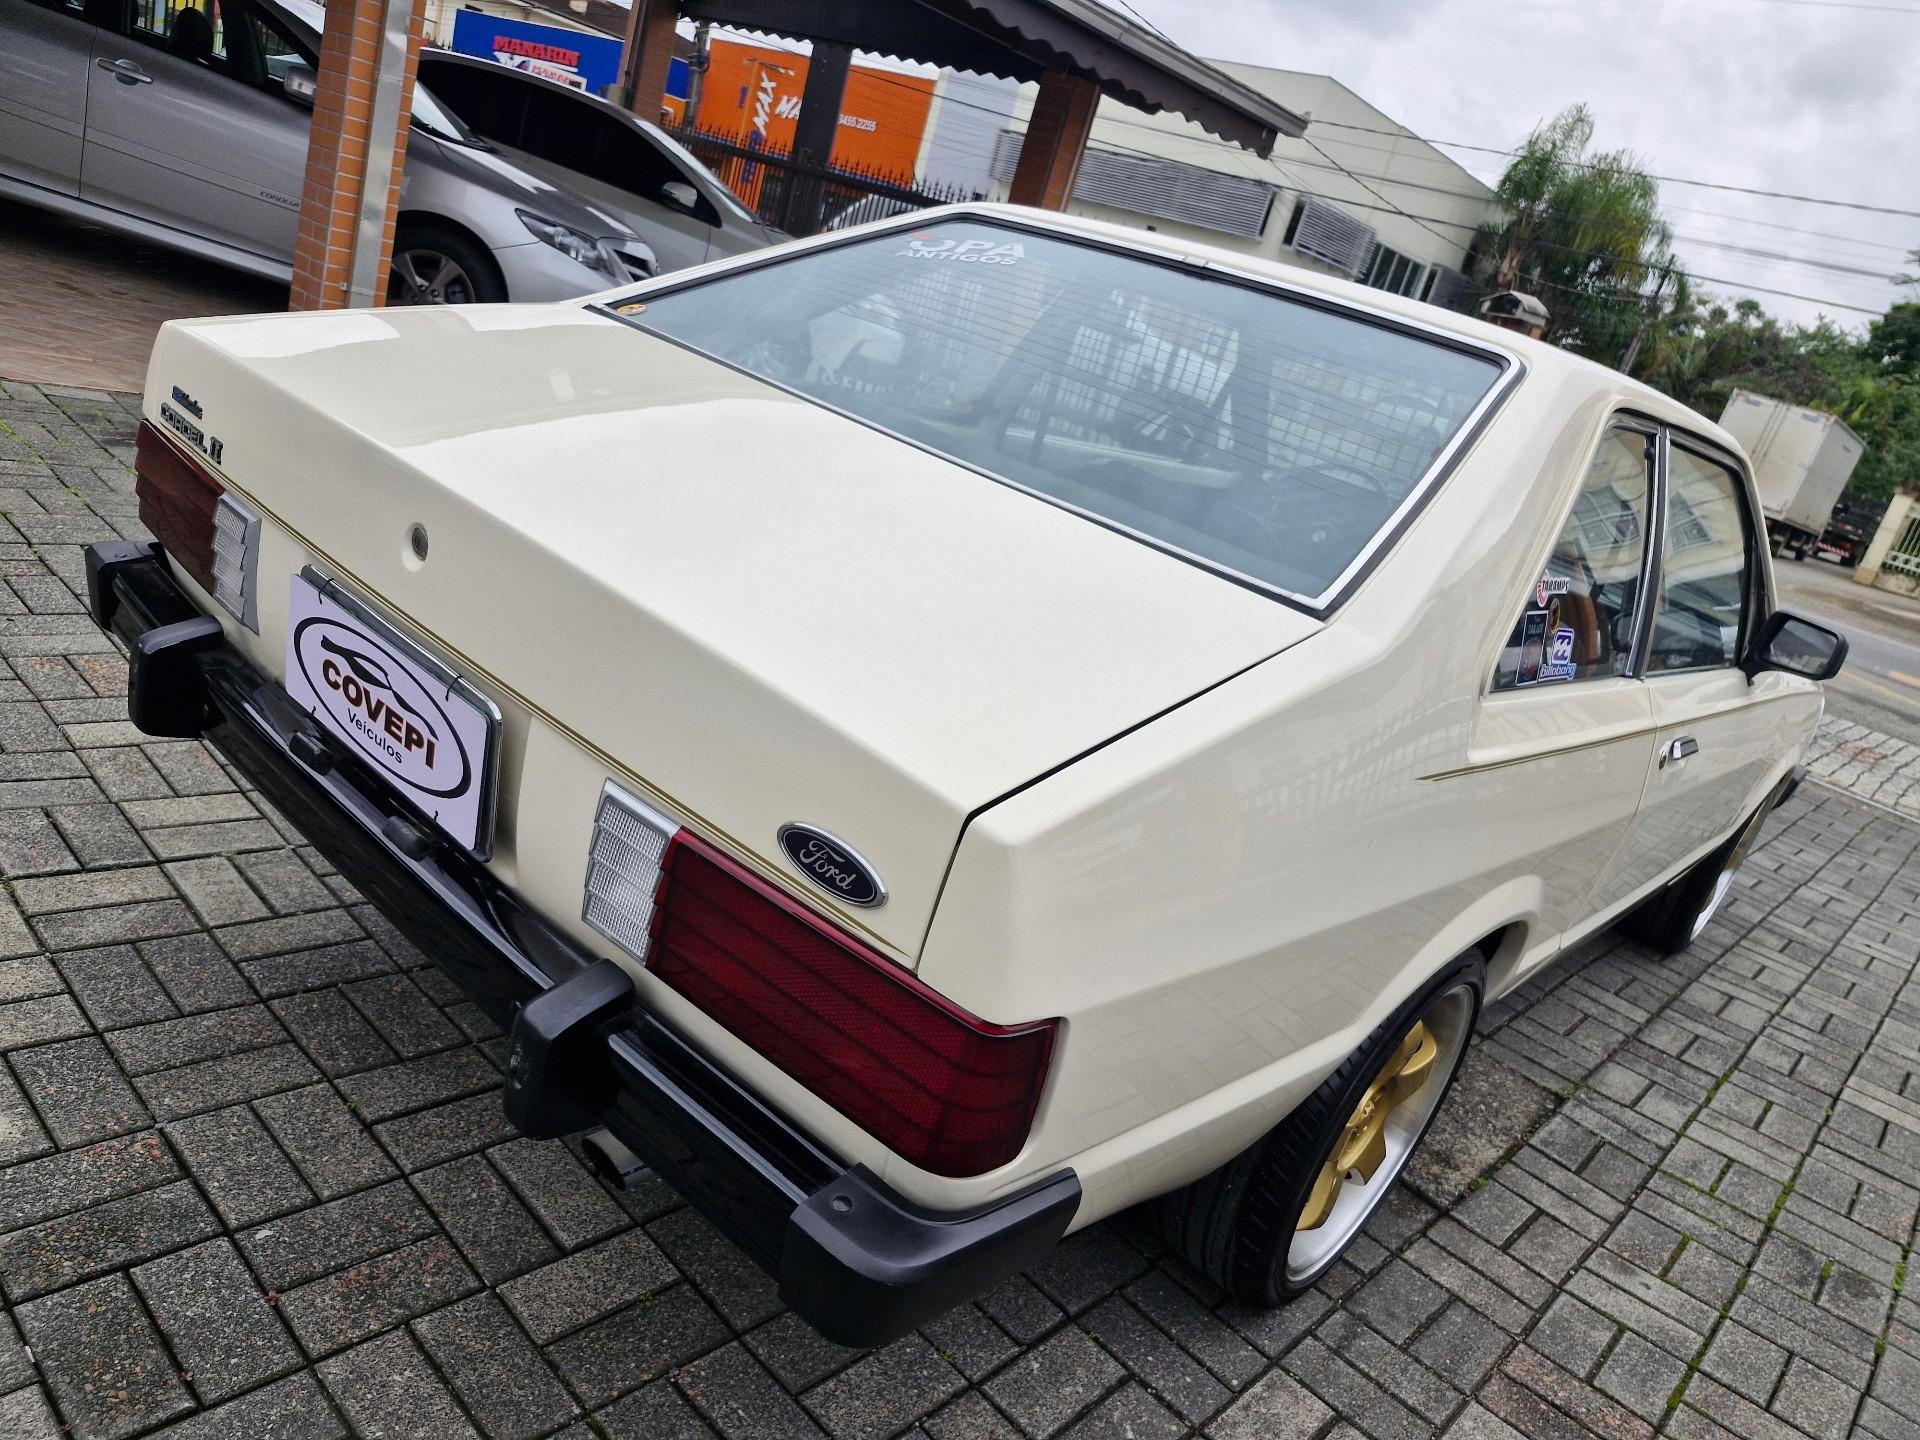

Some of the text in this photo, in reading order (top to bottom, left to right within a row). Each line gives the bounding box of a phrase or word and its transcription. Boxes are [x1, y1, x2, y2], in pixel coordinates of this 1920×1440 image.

[493, 35, 580, 67] MANARIN
[895, 249, 1017, 265] ANTIGOS
[160, 401, 208, 454] CORCEL
[208, 435, 224, 466] II
[322, 659, 436, 771] COVEPI
[799, 840, 857, 890] Ford
